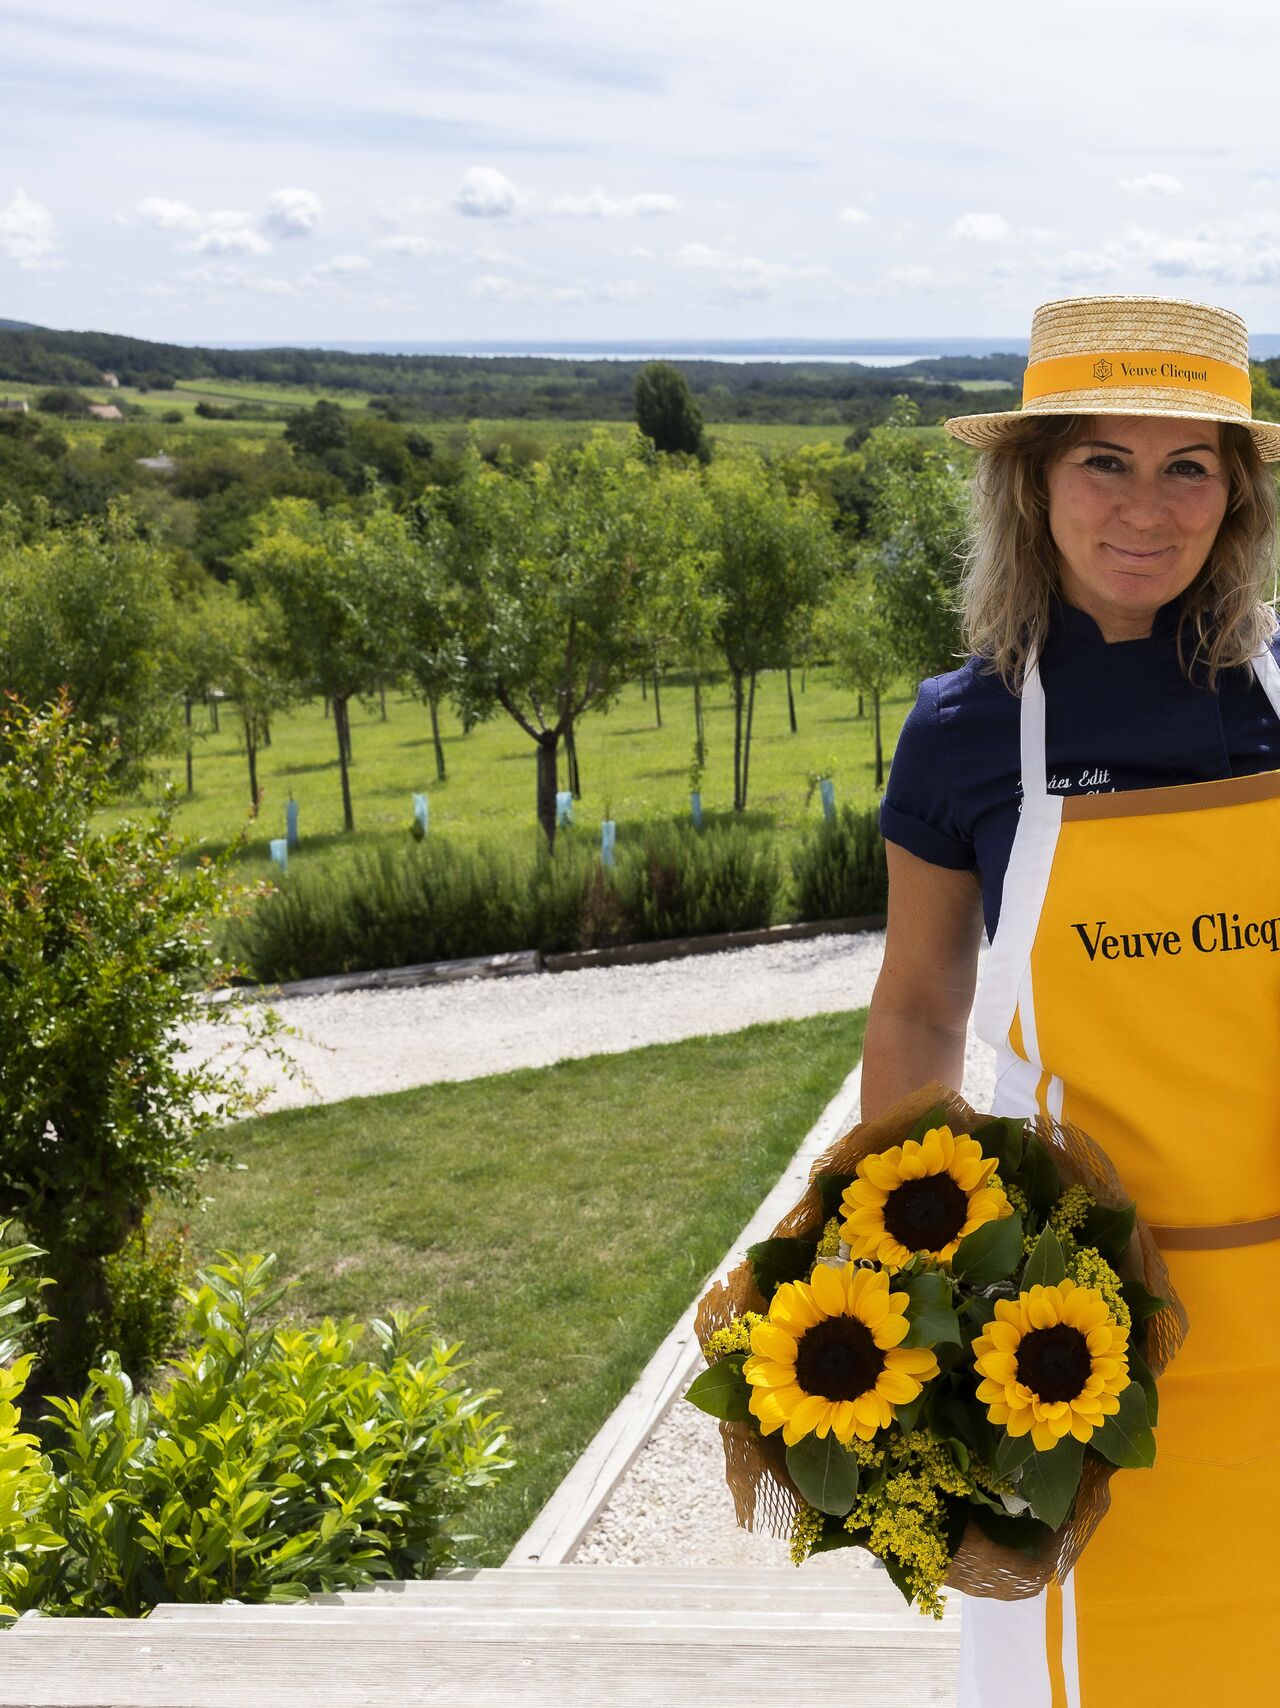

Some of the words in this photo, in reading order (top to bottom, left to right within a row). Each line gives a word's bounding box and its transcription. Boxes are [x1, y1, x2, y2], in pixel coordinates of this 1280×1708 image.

[1120, 362, 1157, 376] Veuve
[1161, 363, 1207, 382] Clicquot
[1078, 768, 1111, 787] Edit
[1071, 921, 1182, 961] Veuve
